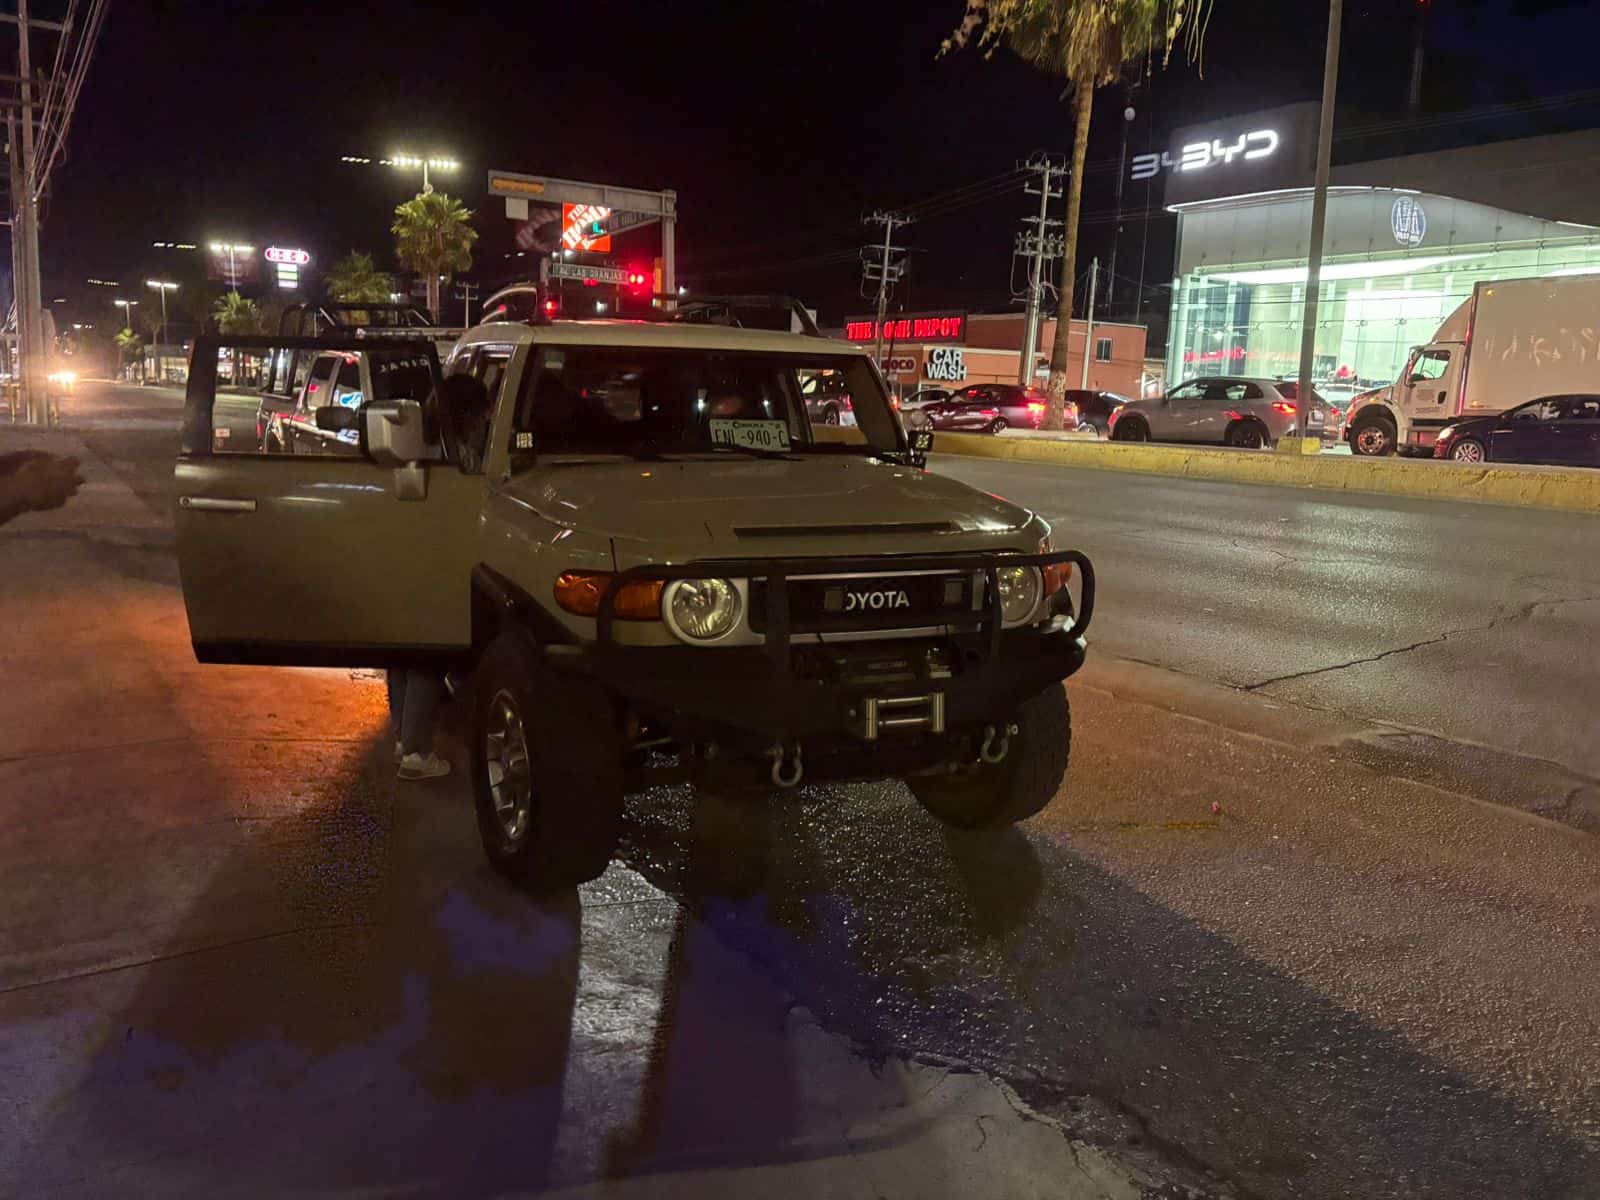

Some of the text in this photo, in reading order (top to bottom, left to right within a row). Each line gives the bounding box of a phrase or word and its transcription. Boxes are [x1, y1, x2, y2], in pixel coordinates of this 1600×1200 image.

[1181, 130, 1279, 170] BYD
[846, 322, 872, 340] THE
[914, 317, 961, 338] DEPOT
[932, 348, 962, 365] CAR
[927, 364, 967, 381] WASH
[845, 590, 910, 611] OYOTA
